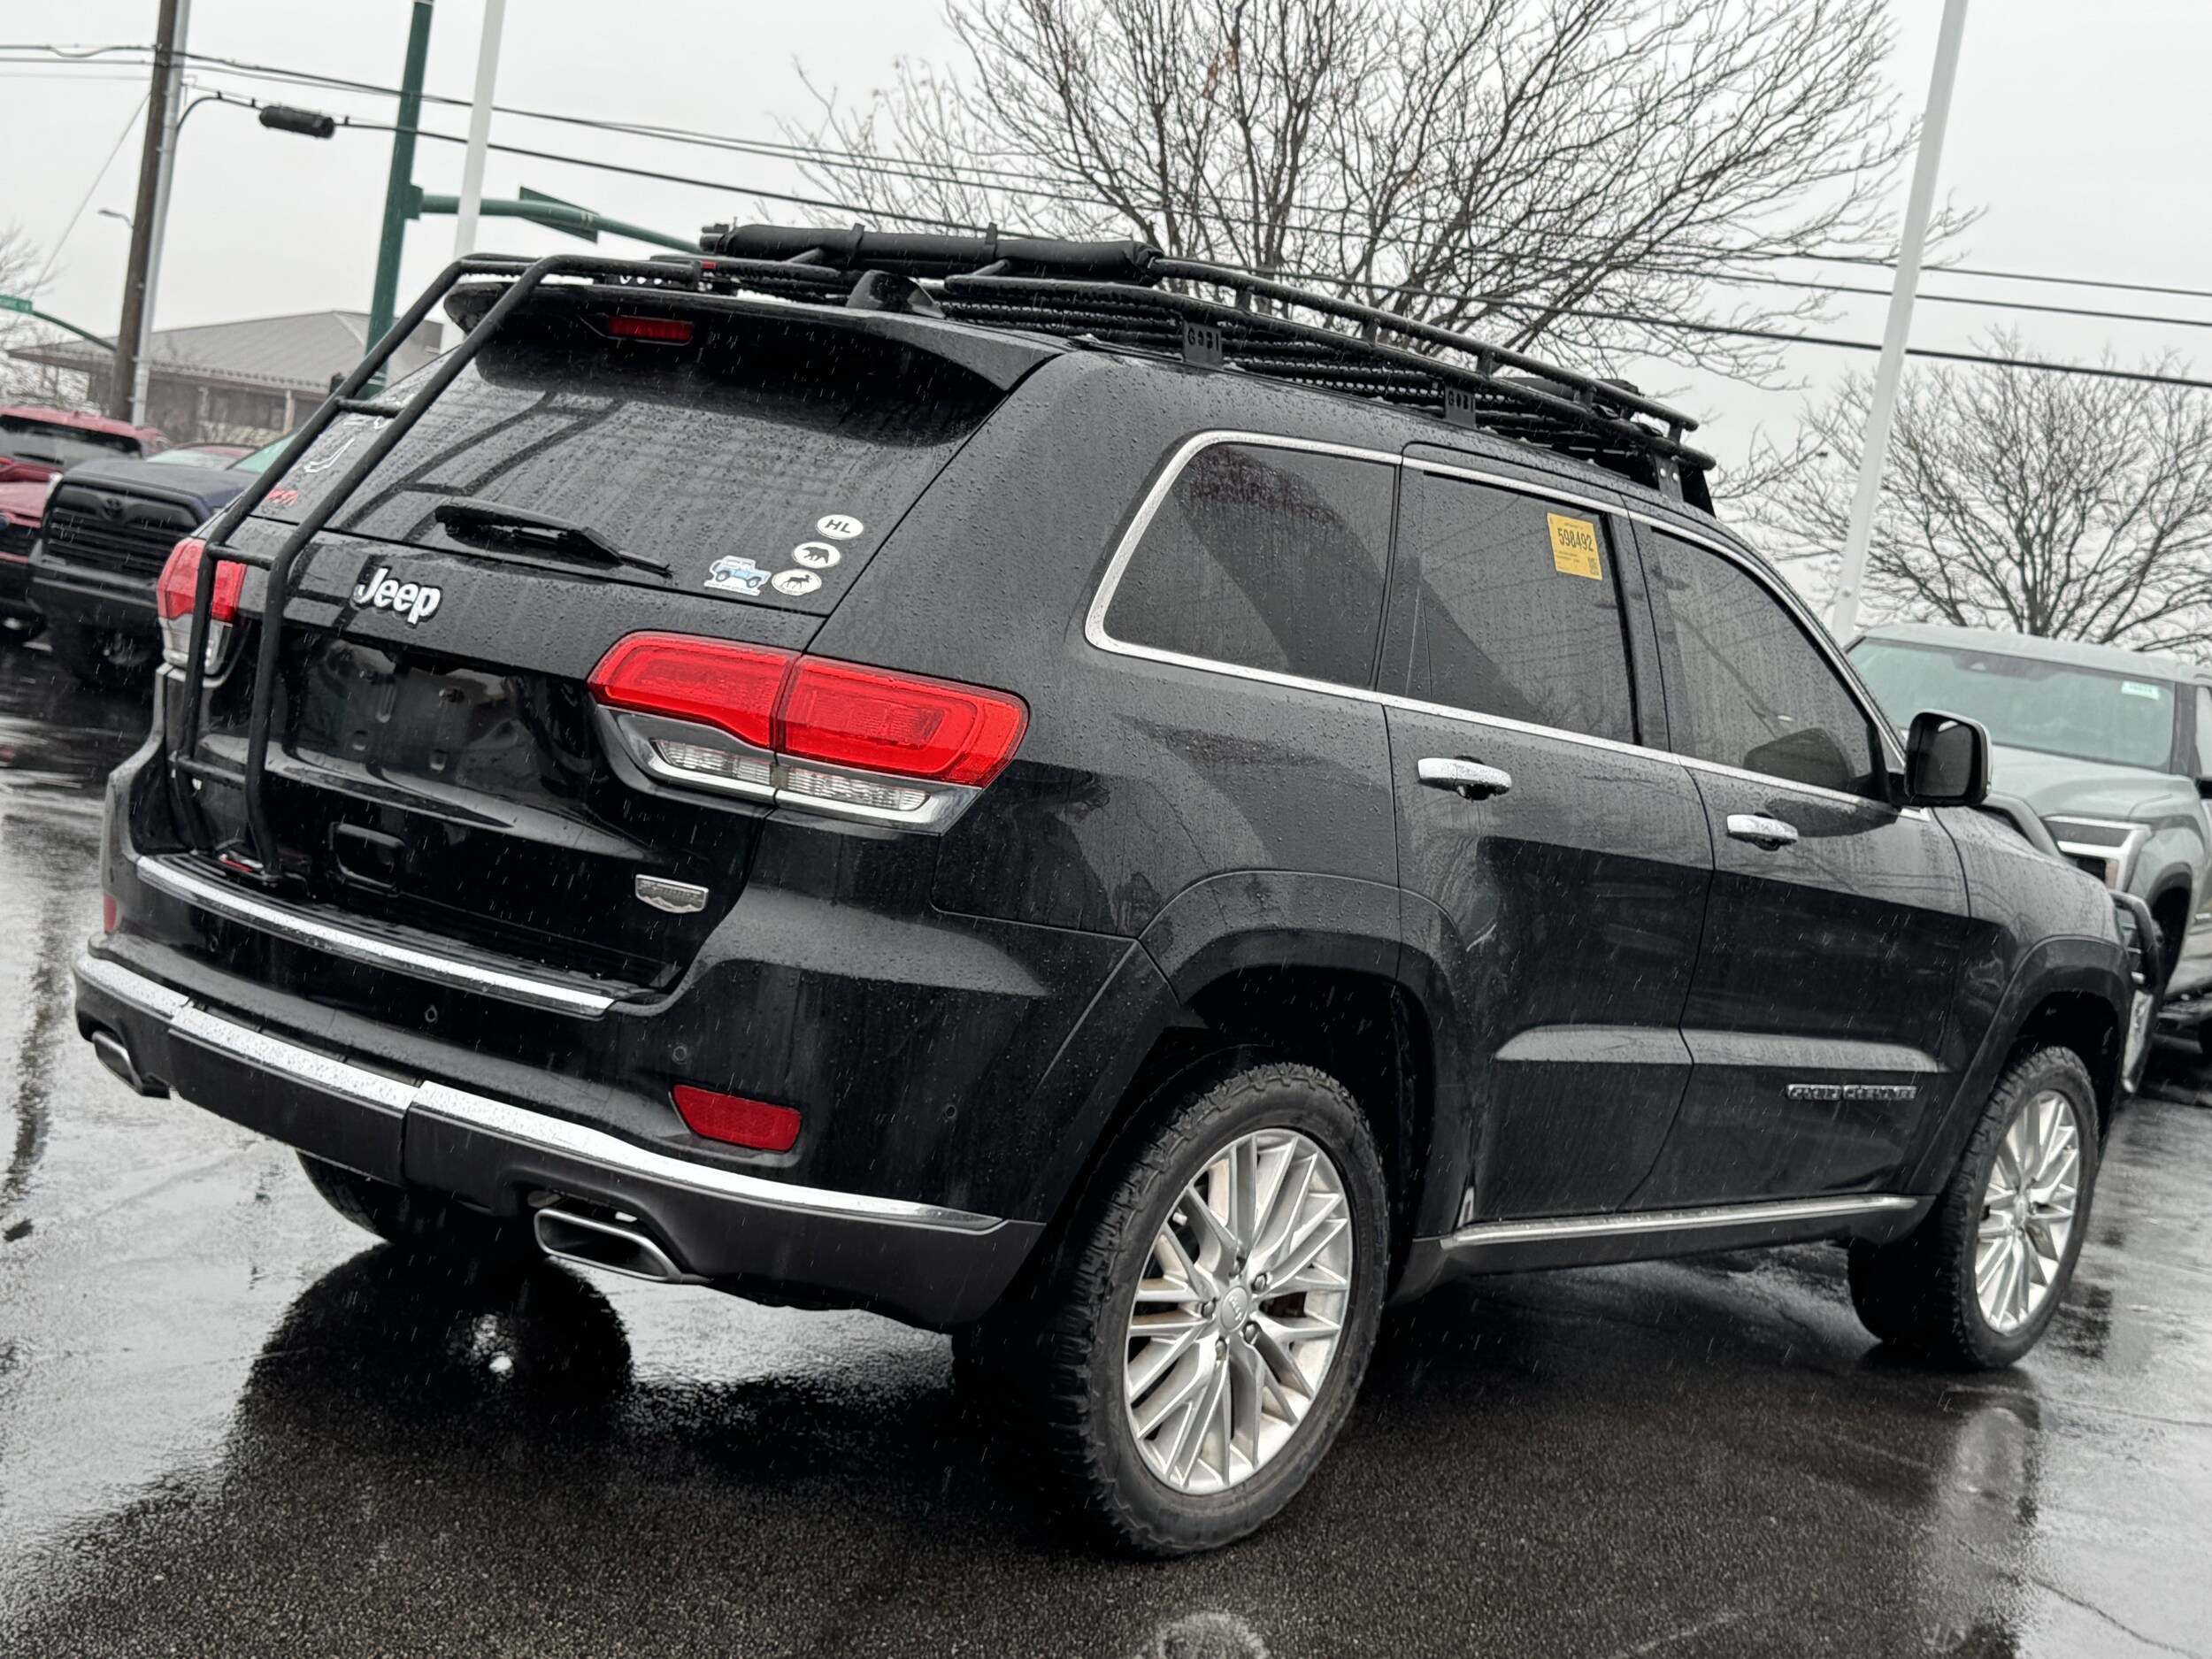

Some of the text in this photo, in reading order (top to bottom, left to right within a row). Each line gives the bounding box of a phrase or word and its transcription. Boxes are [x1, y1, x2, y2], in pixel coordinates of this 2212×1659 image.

[824, 518, 851, 534] HL
[1557, 527, 1594, 552] 598492
[352, 567, 441, 626] Jeep
